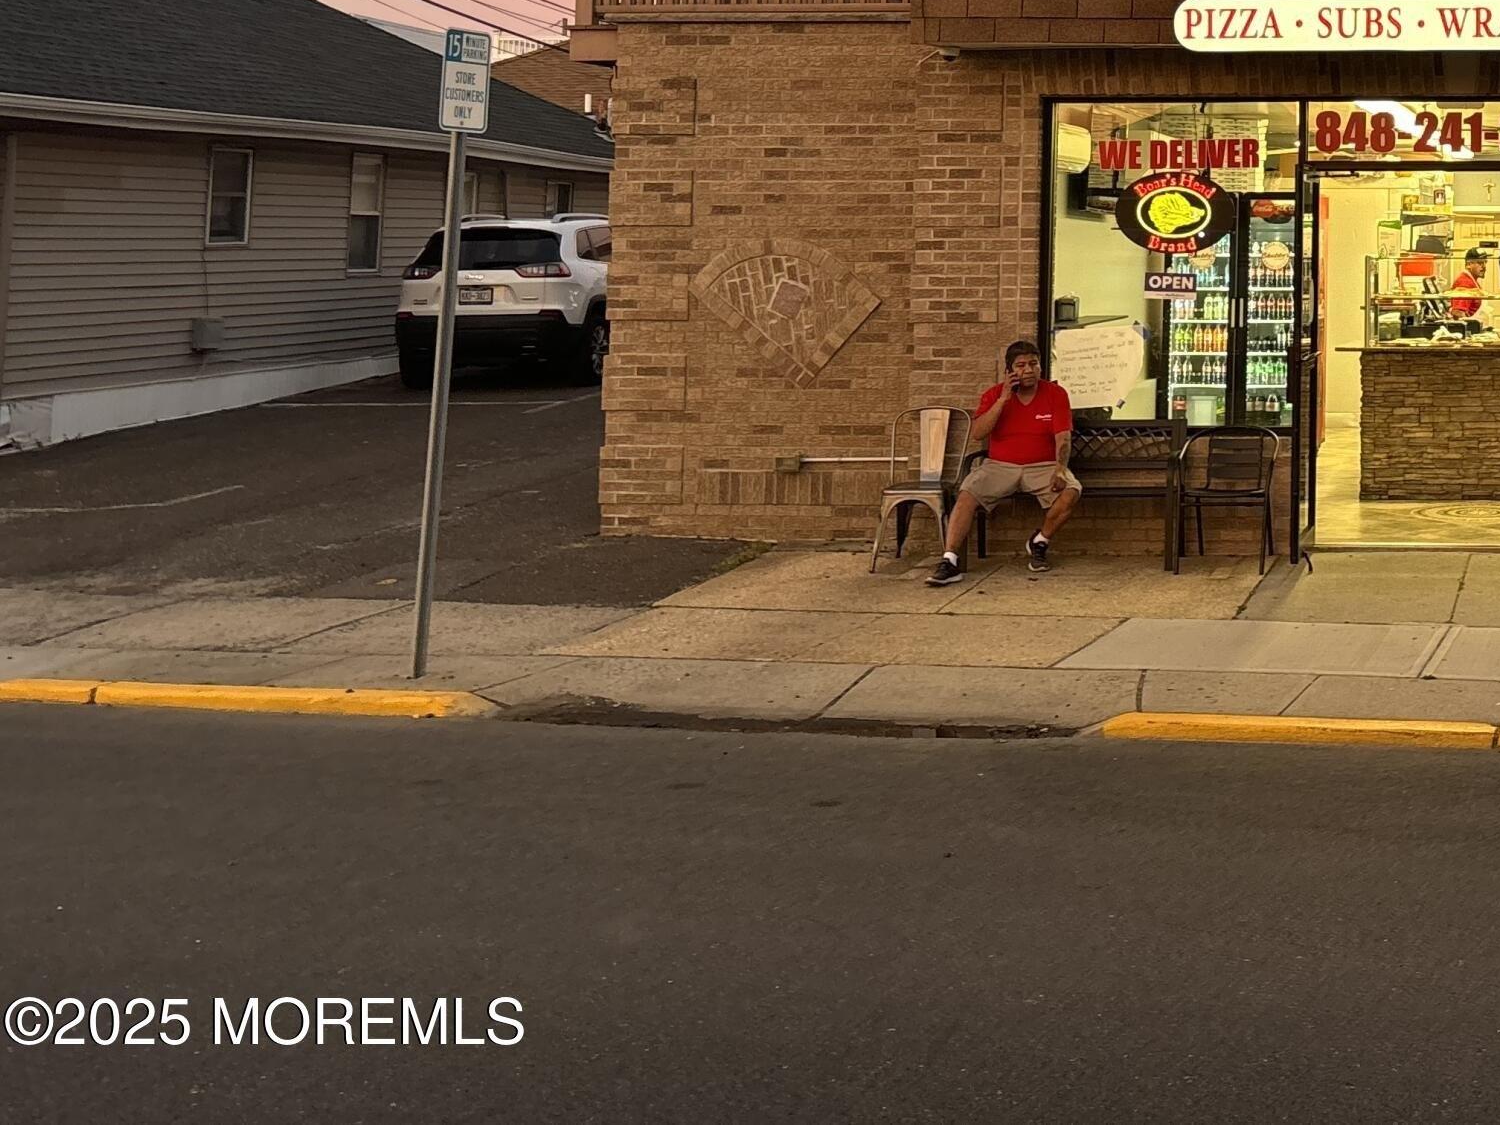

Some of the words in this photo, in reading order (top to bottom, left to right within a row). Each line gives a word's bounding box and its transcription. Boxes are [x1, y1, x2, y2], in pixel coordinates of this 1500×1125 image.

[1183, 7, 1283, 39] PIZZA
[1317, 6, 1402, 38] SUBS
[449, 34, 461, 57] 15
[455, 71, 477, 85] STORE
[445, 87, 484, 103] CUSTOMERS
[454, 106, 472, 119] ONLY
[1099, 139, 1142, 169] WE
[1150, 138, 1260, 169] DELIVER
[1134, 174, 1177, 197] Boar's
[1180, 174, 1216, 199] Head
[1148, 236, 1197, 251] Brand
[1149, 275, 1194, 289] OPEN
